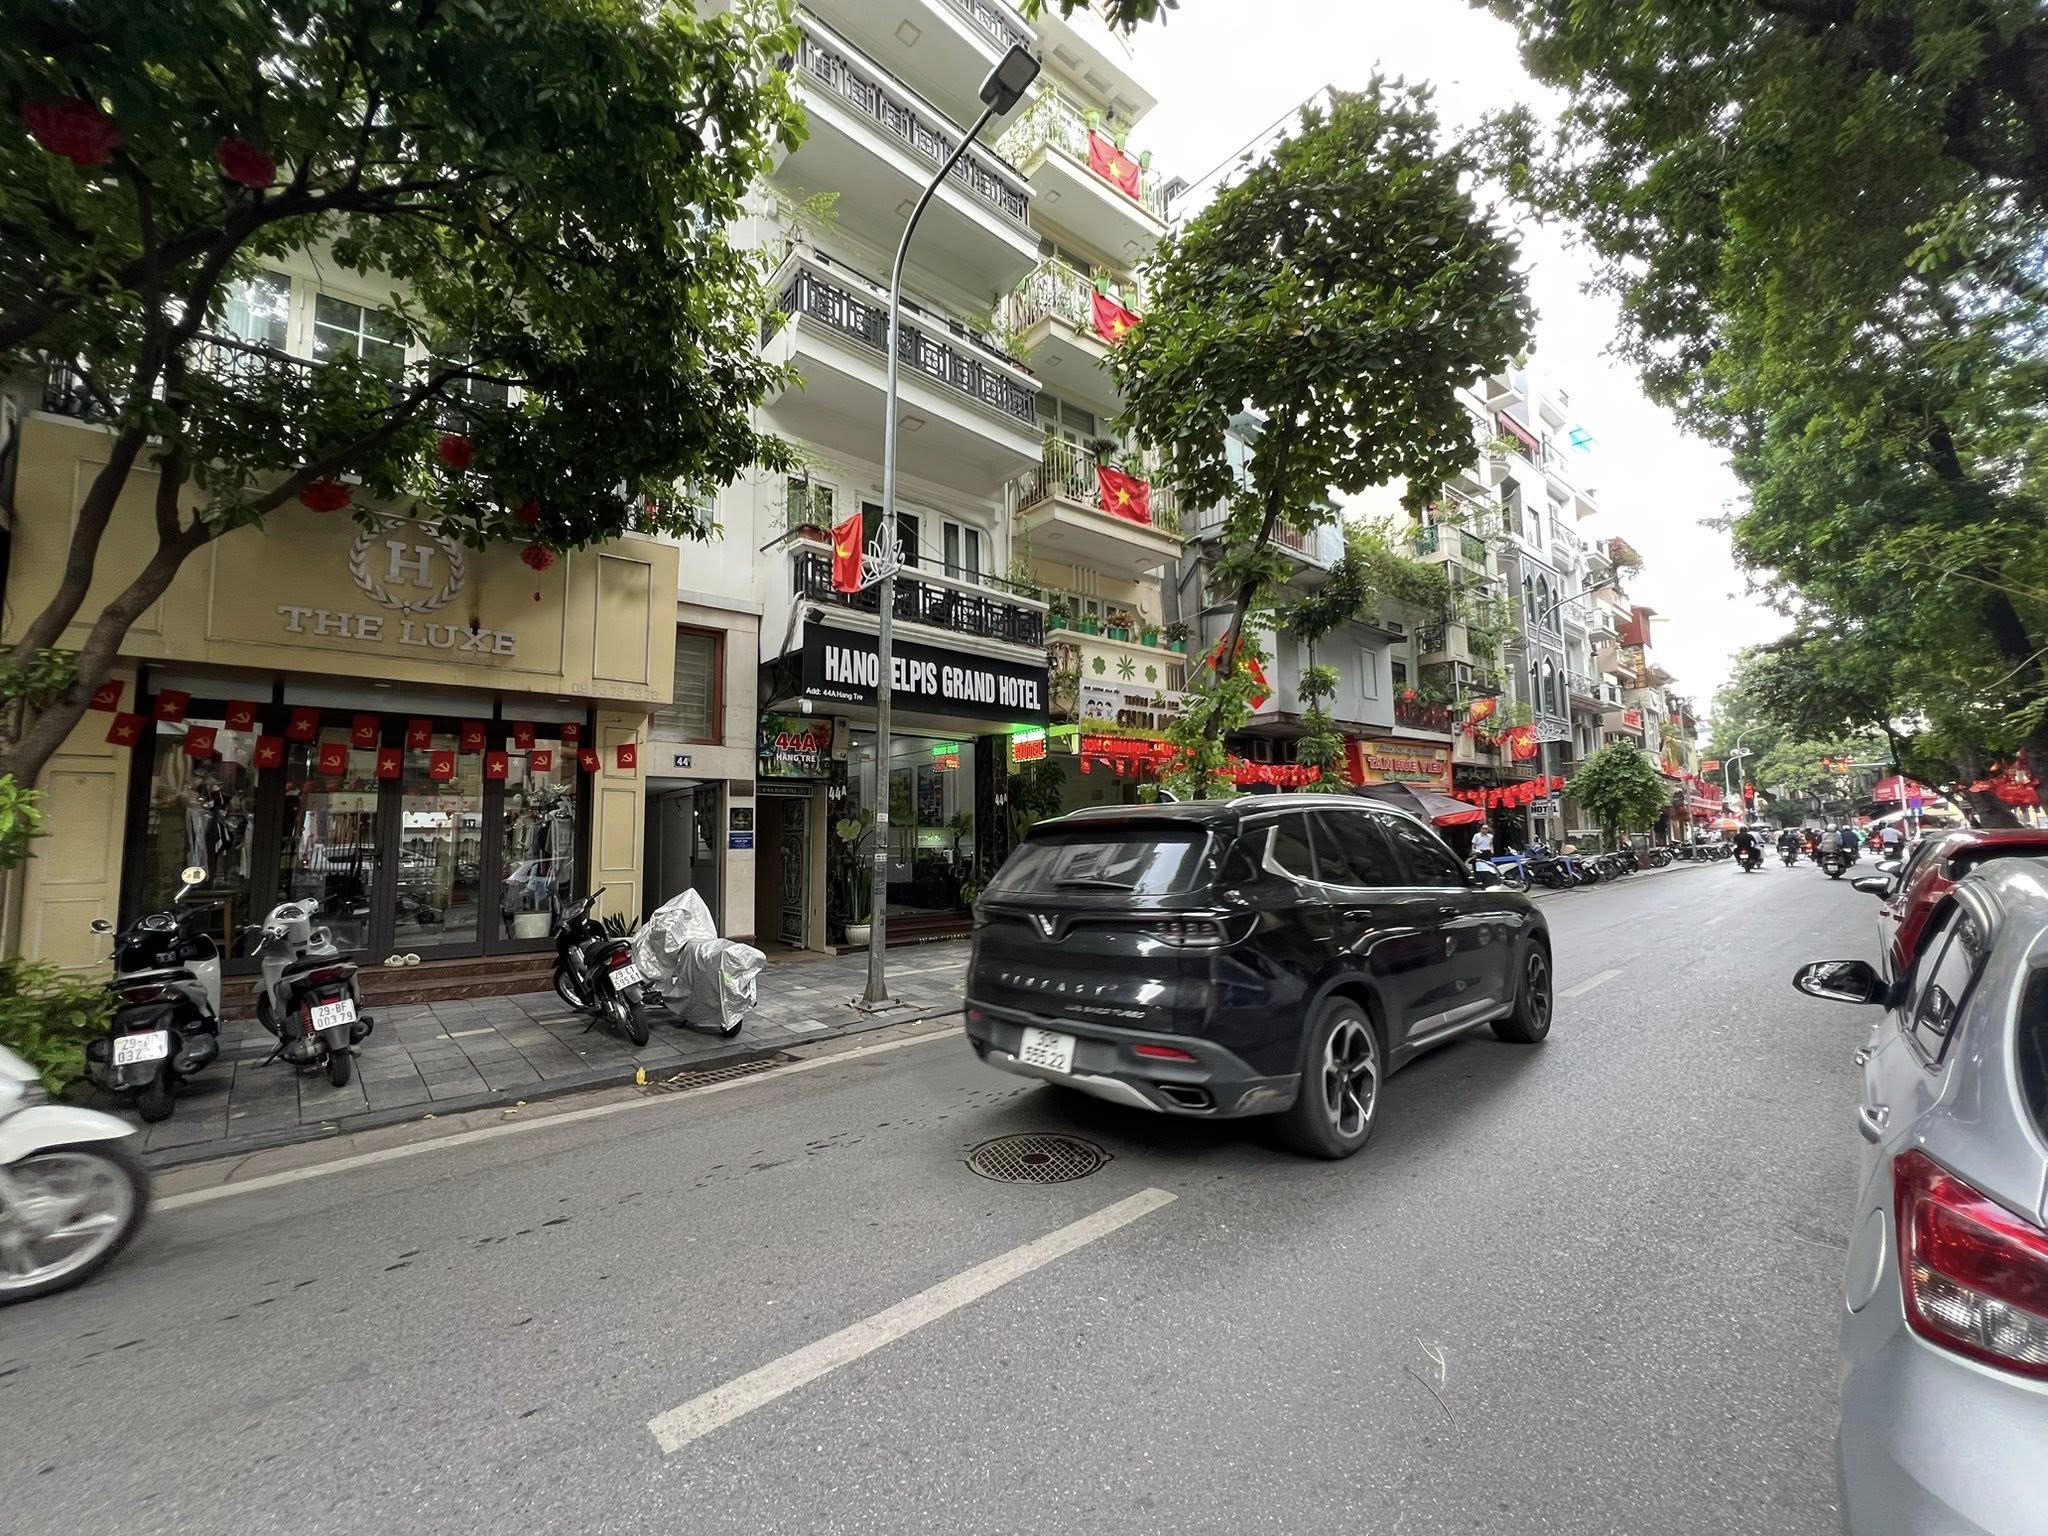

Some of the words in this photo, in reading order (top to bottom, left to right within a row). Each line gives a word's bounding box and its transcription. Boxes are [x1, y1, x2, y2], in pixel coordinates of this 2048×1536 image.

[384, 540, 434, 588] H
[278, 605, 384, 641] THE
[400, 619, 516, 656] LUXE
[825, 645, 879, 688] HANO
[890, 656, 937, 695] ELPIS
[942, 665, 995, 703] GRAND
[999, 675, 1041, 710] HOTEL
[823, 689, 837, 697] 44A
[775, 731, 817, 752] 44A
[1013, 741, 1044, 760] HOTEL
[676, 757, 689, 766] 44
[800, 754, 816, 763] TRE
[829, 785, 847, 800] 44A
[1531, 805, 1558, 813] HOTL
[319, 1002, 347, 1016] 29-BF
